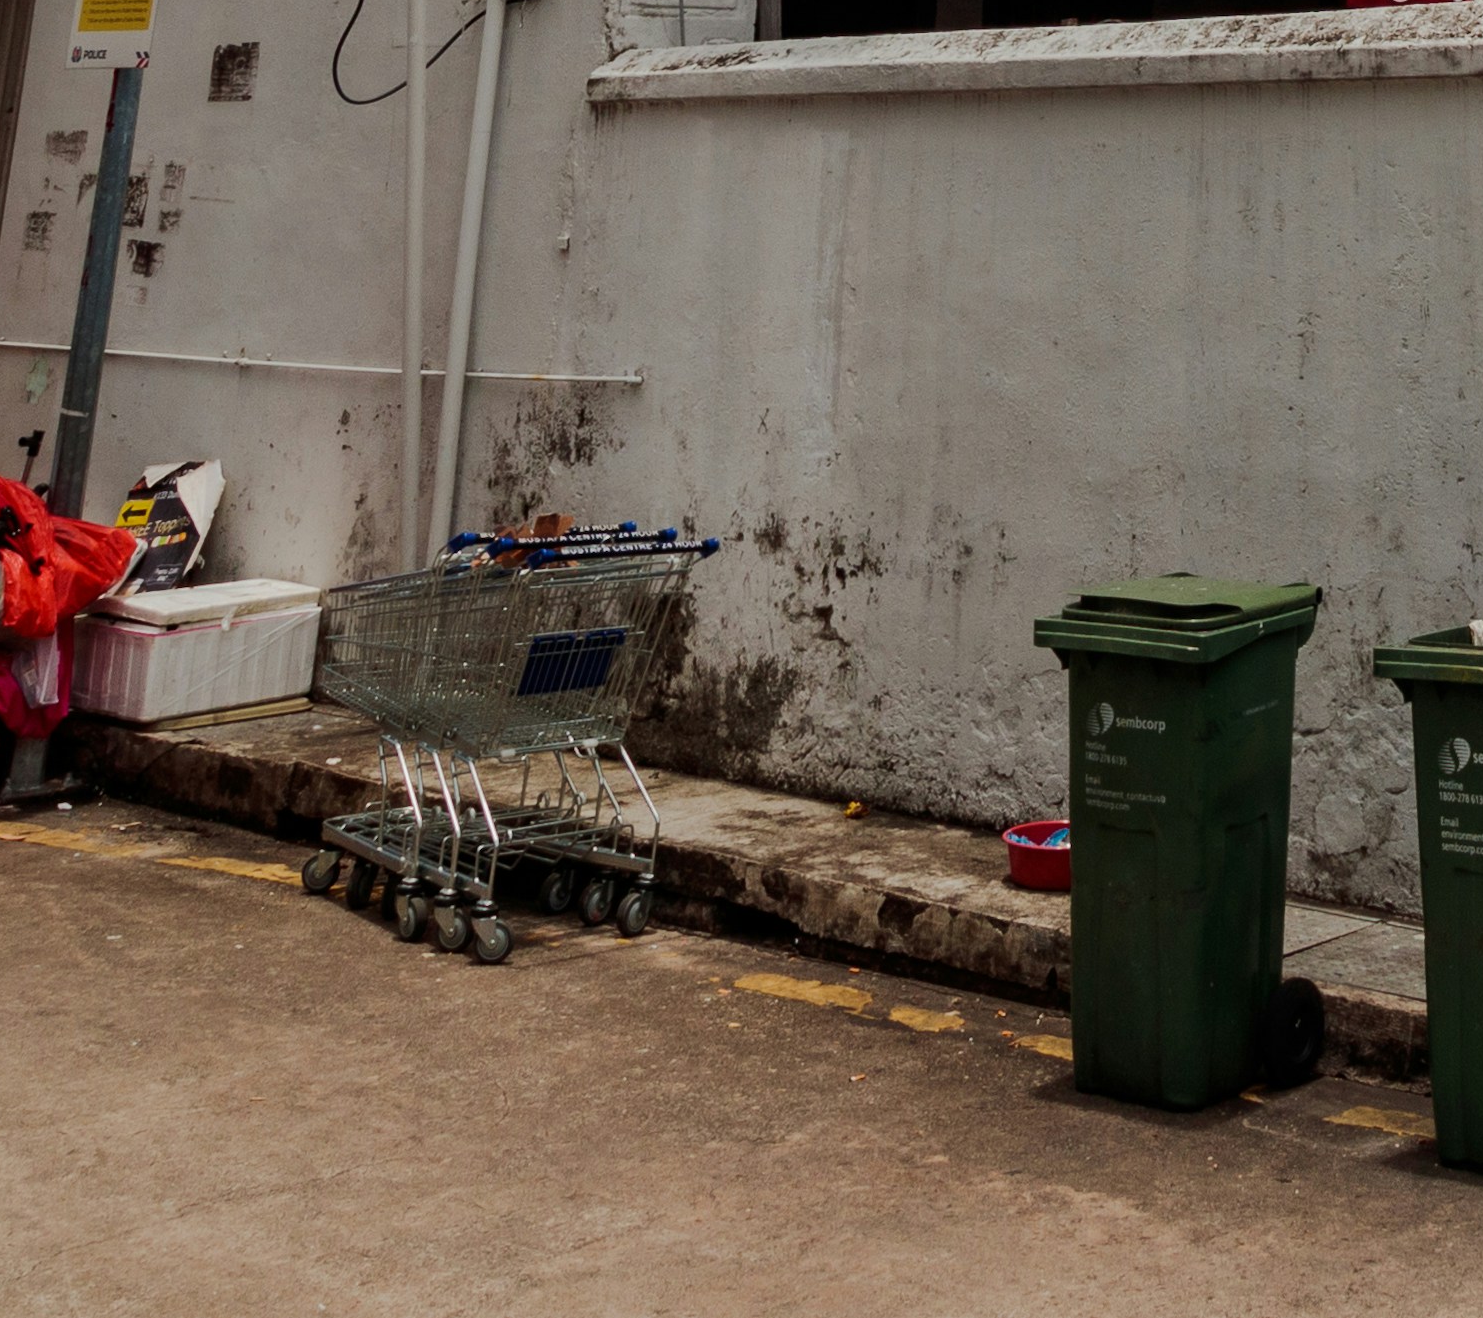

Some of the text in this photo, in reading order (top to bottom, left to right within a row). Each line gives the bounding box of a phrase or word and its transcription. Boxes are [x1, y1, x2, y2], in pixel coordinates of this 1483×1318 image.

[82, 49, 107, 61] POLICE
[518, 534, 567, 544] MUSTAFA
[561, 539, 704, 555] MUSTAFA CENTRE 24 HOUR
[1115, 715, 1167, 734] sembcorp
[1438, 779, 1464, 792] Hotline
[1439, 791, 1470, 805] 1800-278
[1440, 816, 1460, 828] Email
